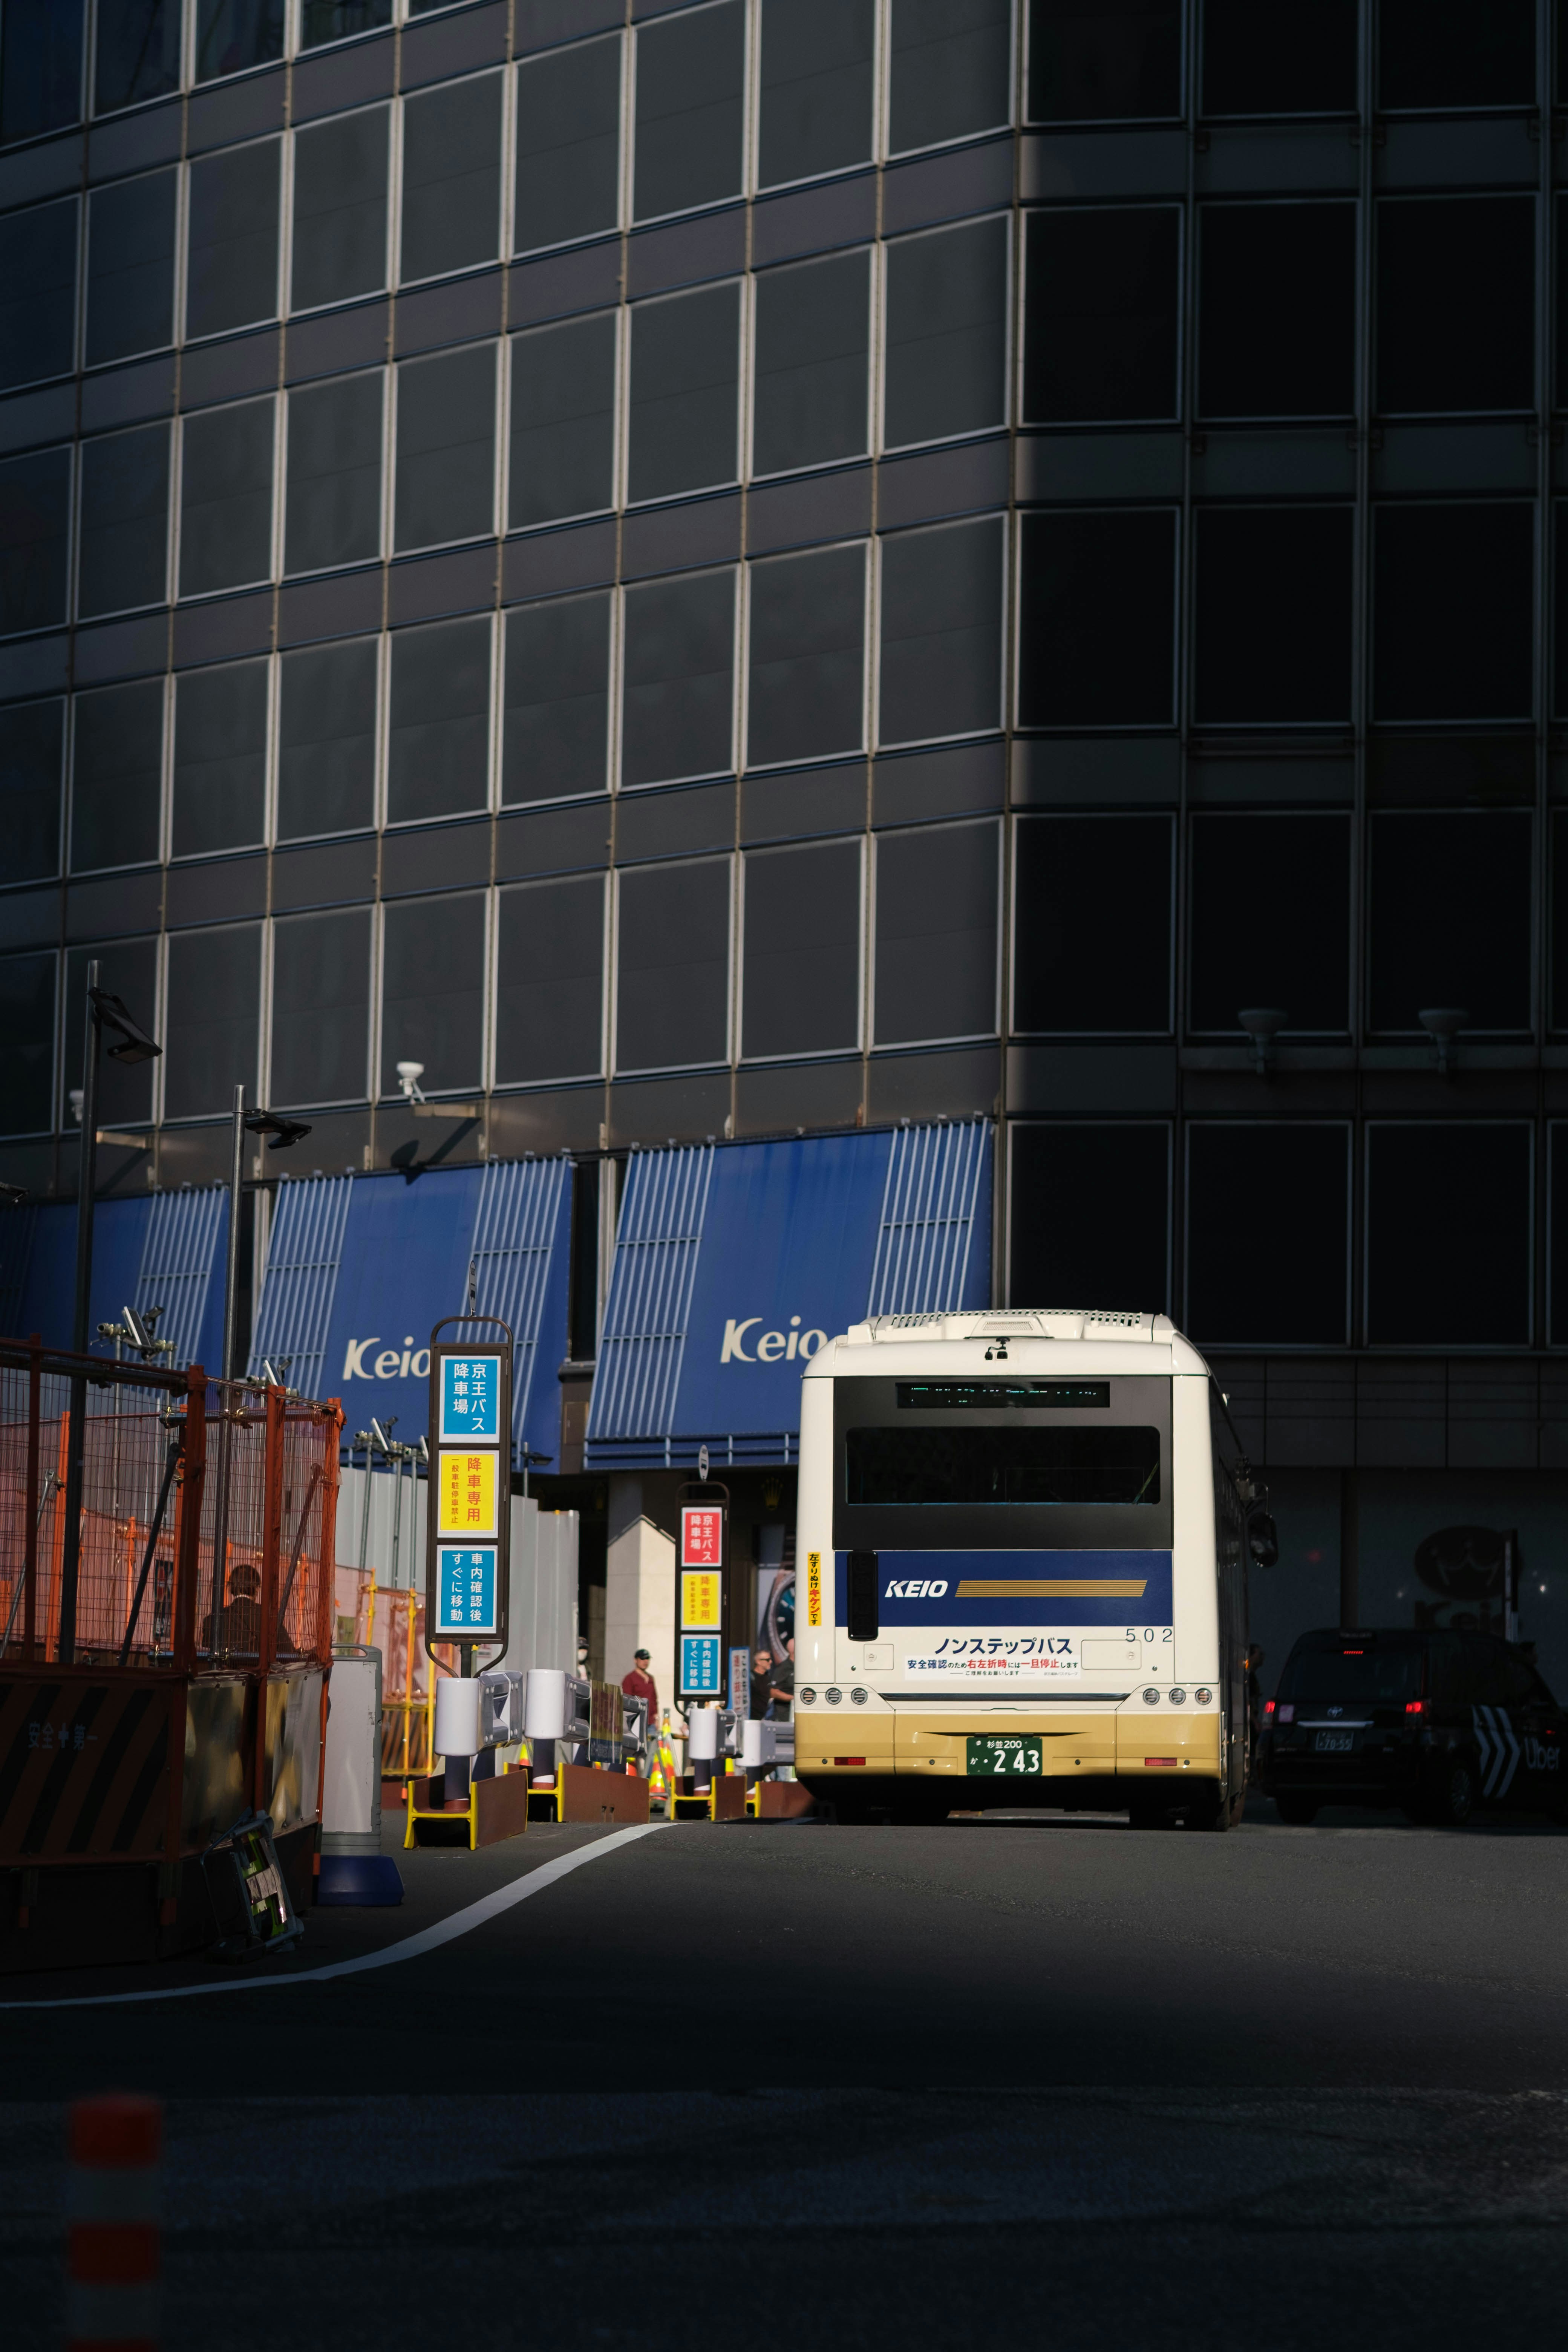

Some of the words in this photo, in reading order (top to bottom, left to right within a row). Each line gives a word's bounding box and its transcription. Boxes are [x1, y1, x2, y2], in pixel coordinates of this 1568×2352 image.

[343, 1336, 430, 1380] Keio
[720, 1315, 828, 1363] Keio
[453, 1363, 469, 1414] 降車場
[471, 1363, 487, 1430] 京王バス
[467, 1458, 481, 1522] 降車専用
[691, 1515, 701, 1549] 降車場
[702, 1515, 713, 1560] 京王バス
[450, 1553, 464, 1621] すぐに移動
[470, 1553, 483, 1621] 車内確認後
[701, 1576, 710, 1619] 降車専用
[809, 1554, 820, 1625] 左すりぬけキケンです
[885, 1580, 948, 1597] KEIO
[934, 1637, 1073, 1655] ノンステップバス
[1125, 1628, 1173, 1642] 502
[689, 1641, 698, 1686] すぐに移動
[702, 1640, 711, 1687] 車内確認後
[908, 1659, 1078, 1669] 安全確認のため右左折時には一旦停止します
[1524, 1737, 1560, 1771] Uber
